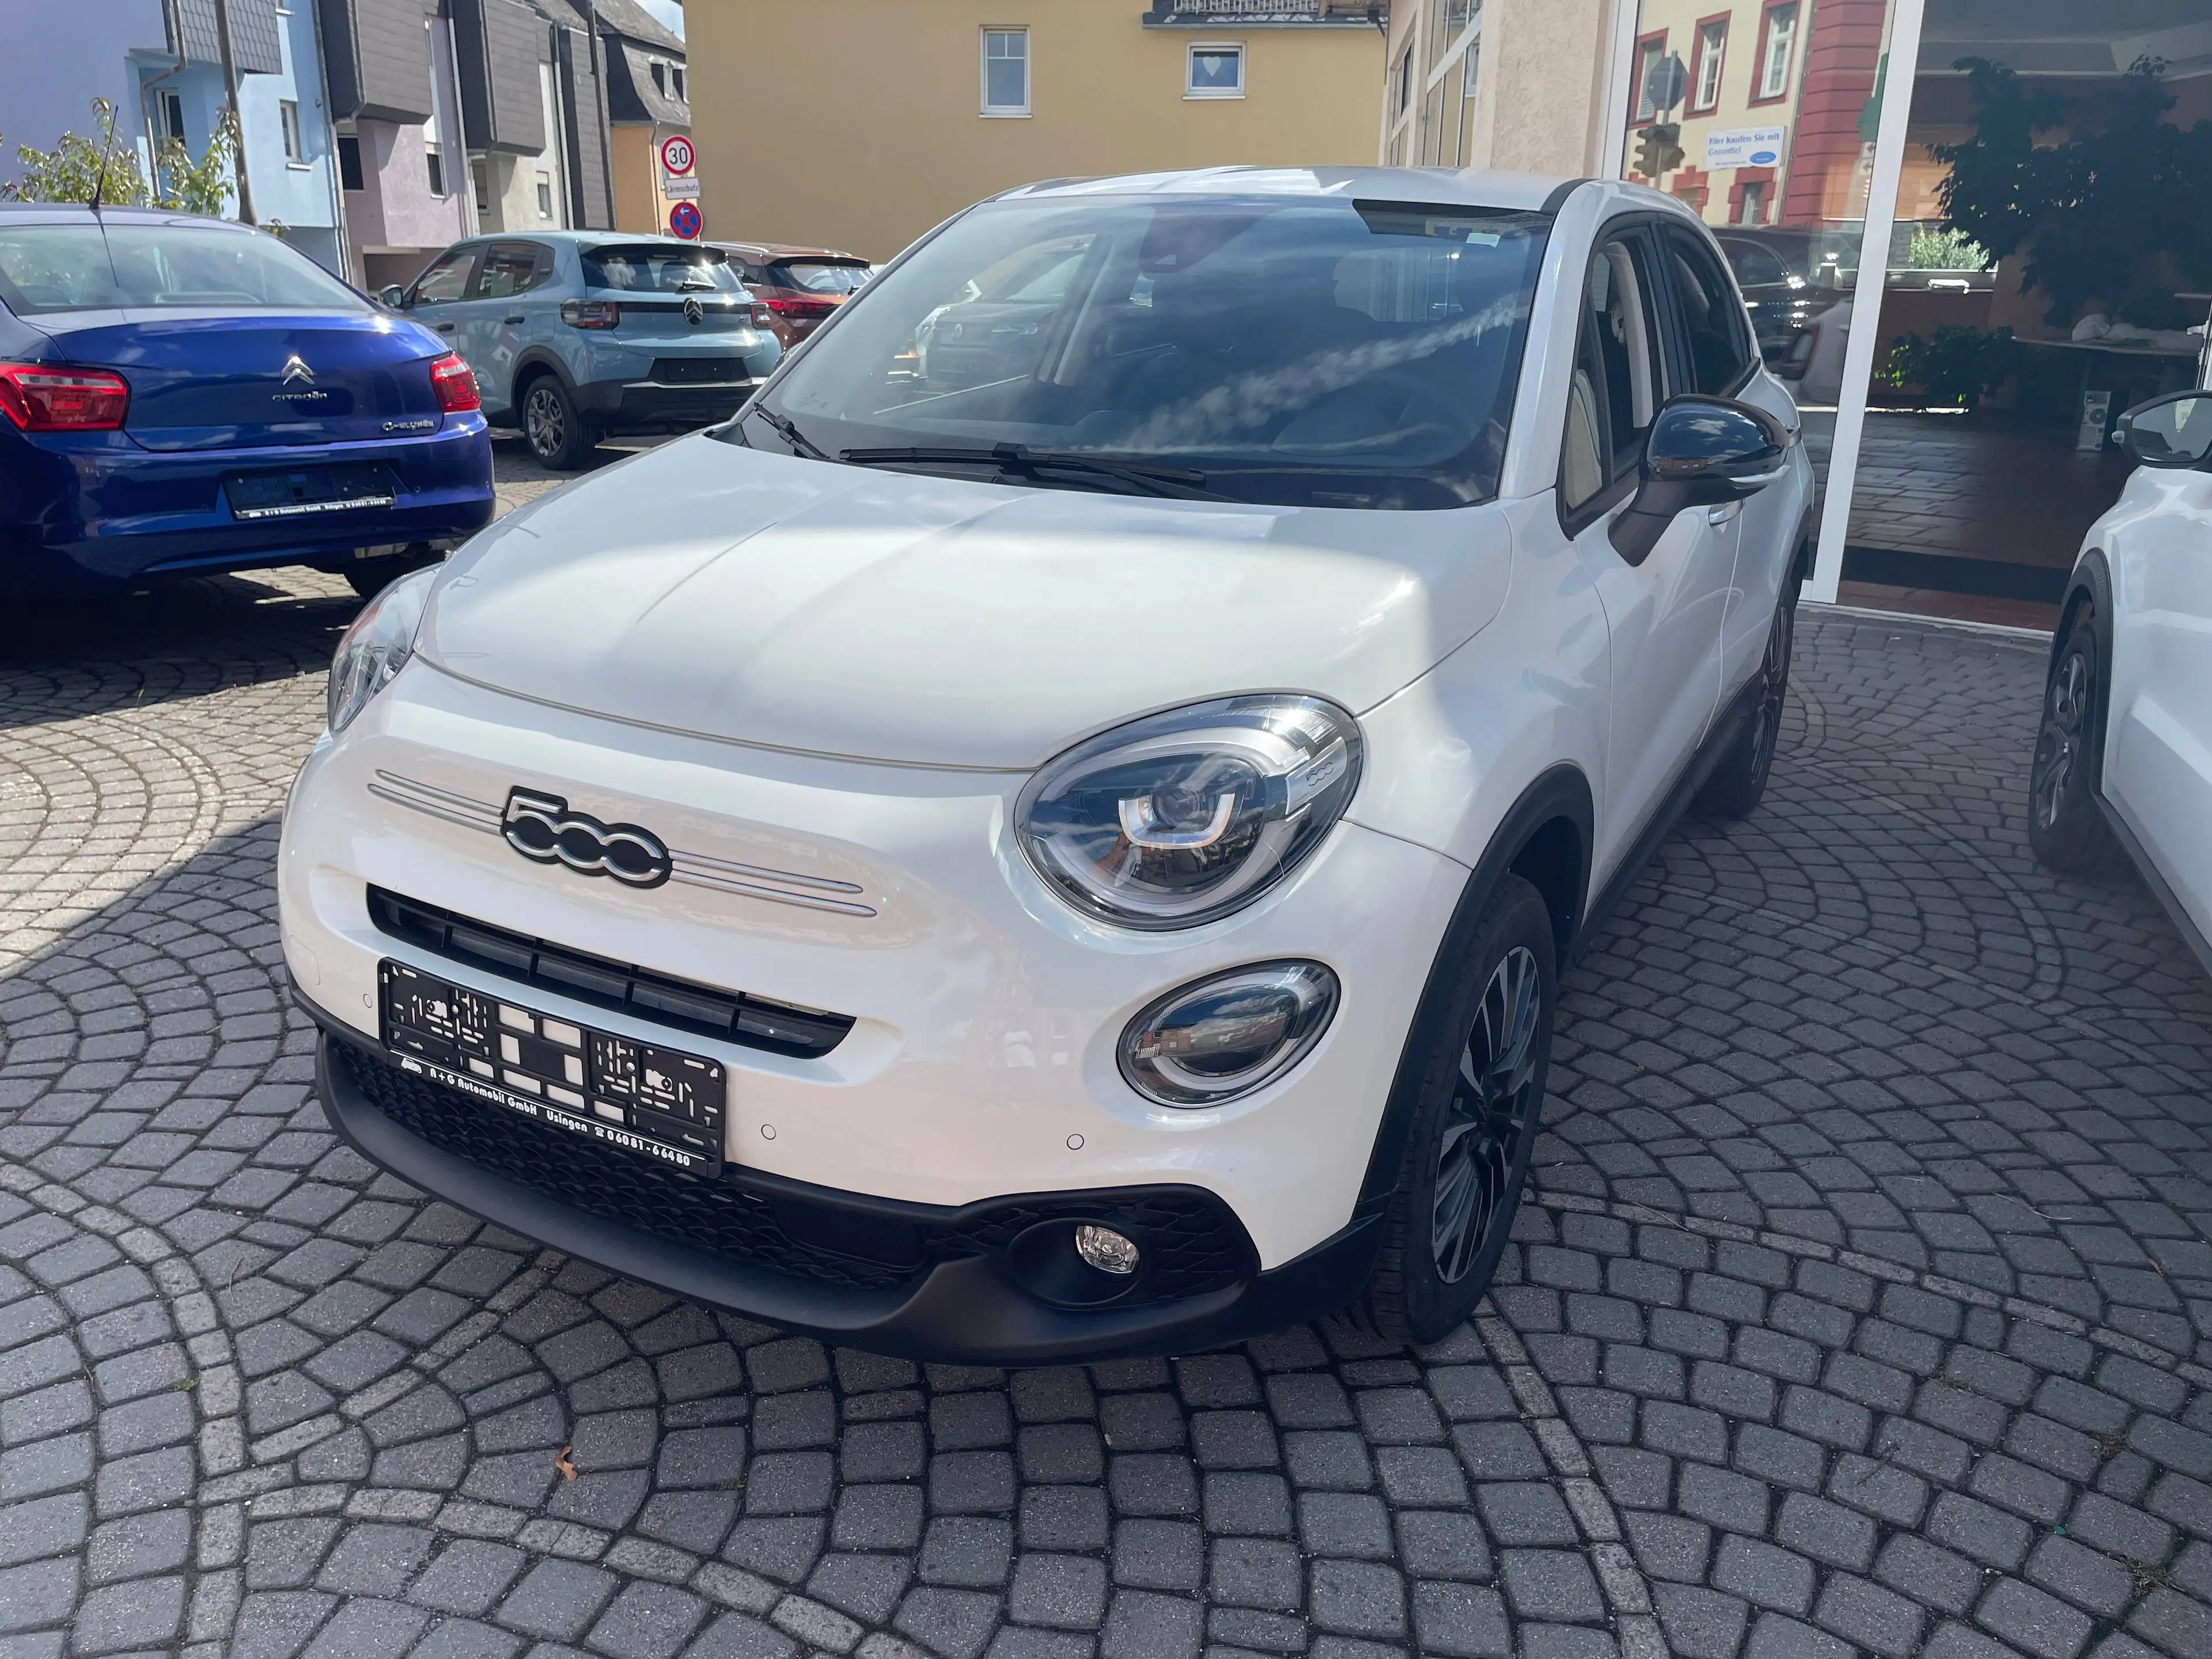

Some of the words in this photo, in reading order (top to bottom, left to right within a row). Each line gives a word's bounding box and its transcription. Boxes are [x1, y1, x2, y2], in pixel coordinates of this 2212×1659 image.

[1709, 137, 1724, 145] Hier
[1726, 134, 1752, 144] kaufen
[669, 147, 688, 164] 30
[666, 184, 698, 193] Lärmschutz
[1306, 762, 1334, 786] 500
[505, 793, 665, 883] 500
[430, 1067, 437, 1079] A
[438, 1072, 446, 1081] +
[447, 1074, 455, 1085] G
[457, 1078, 505, 1104] Automobil
[507, 1097, 537, 1116] GmbH
[546, 1109, 588, 1132] Usingen
[607, 1130, 691, 1166] 06081-66480
